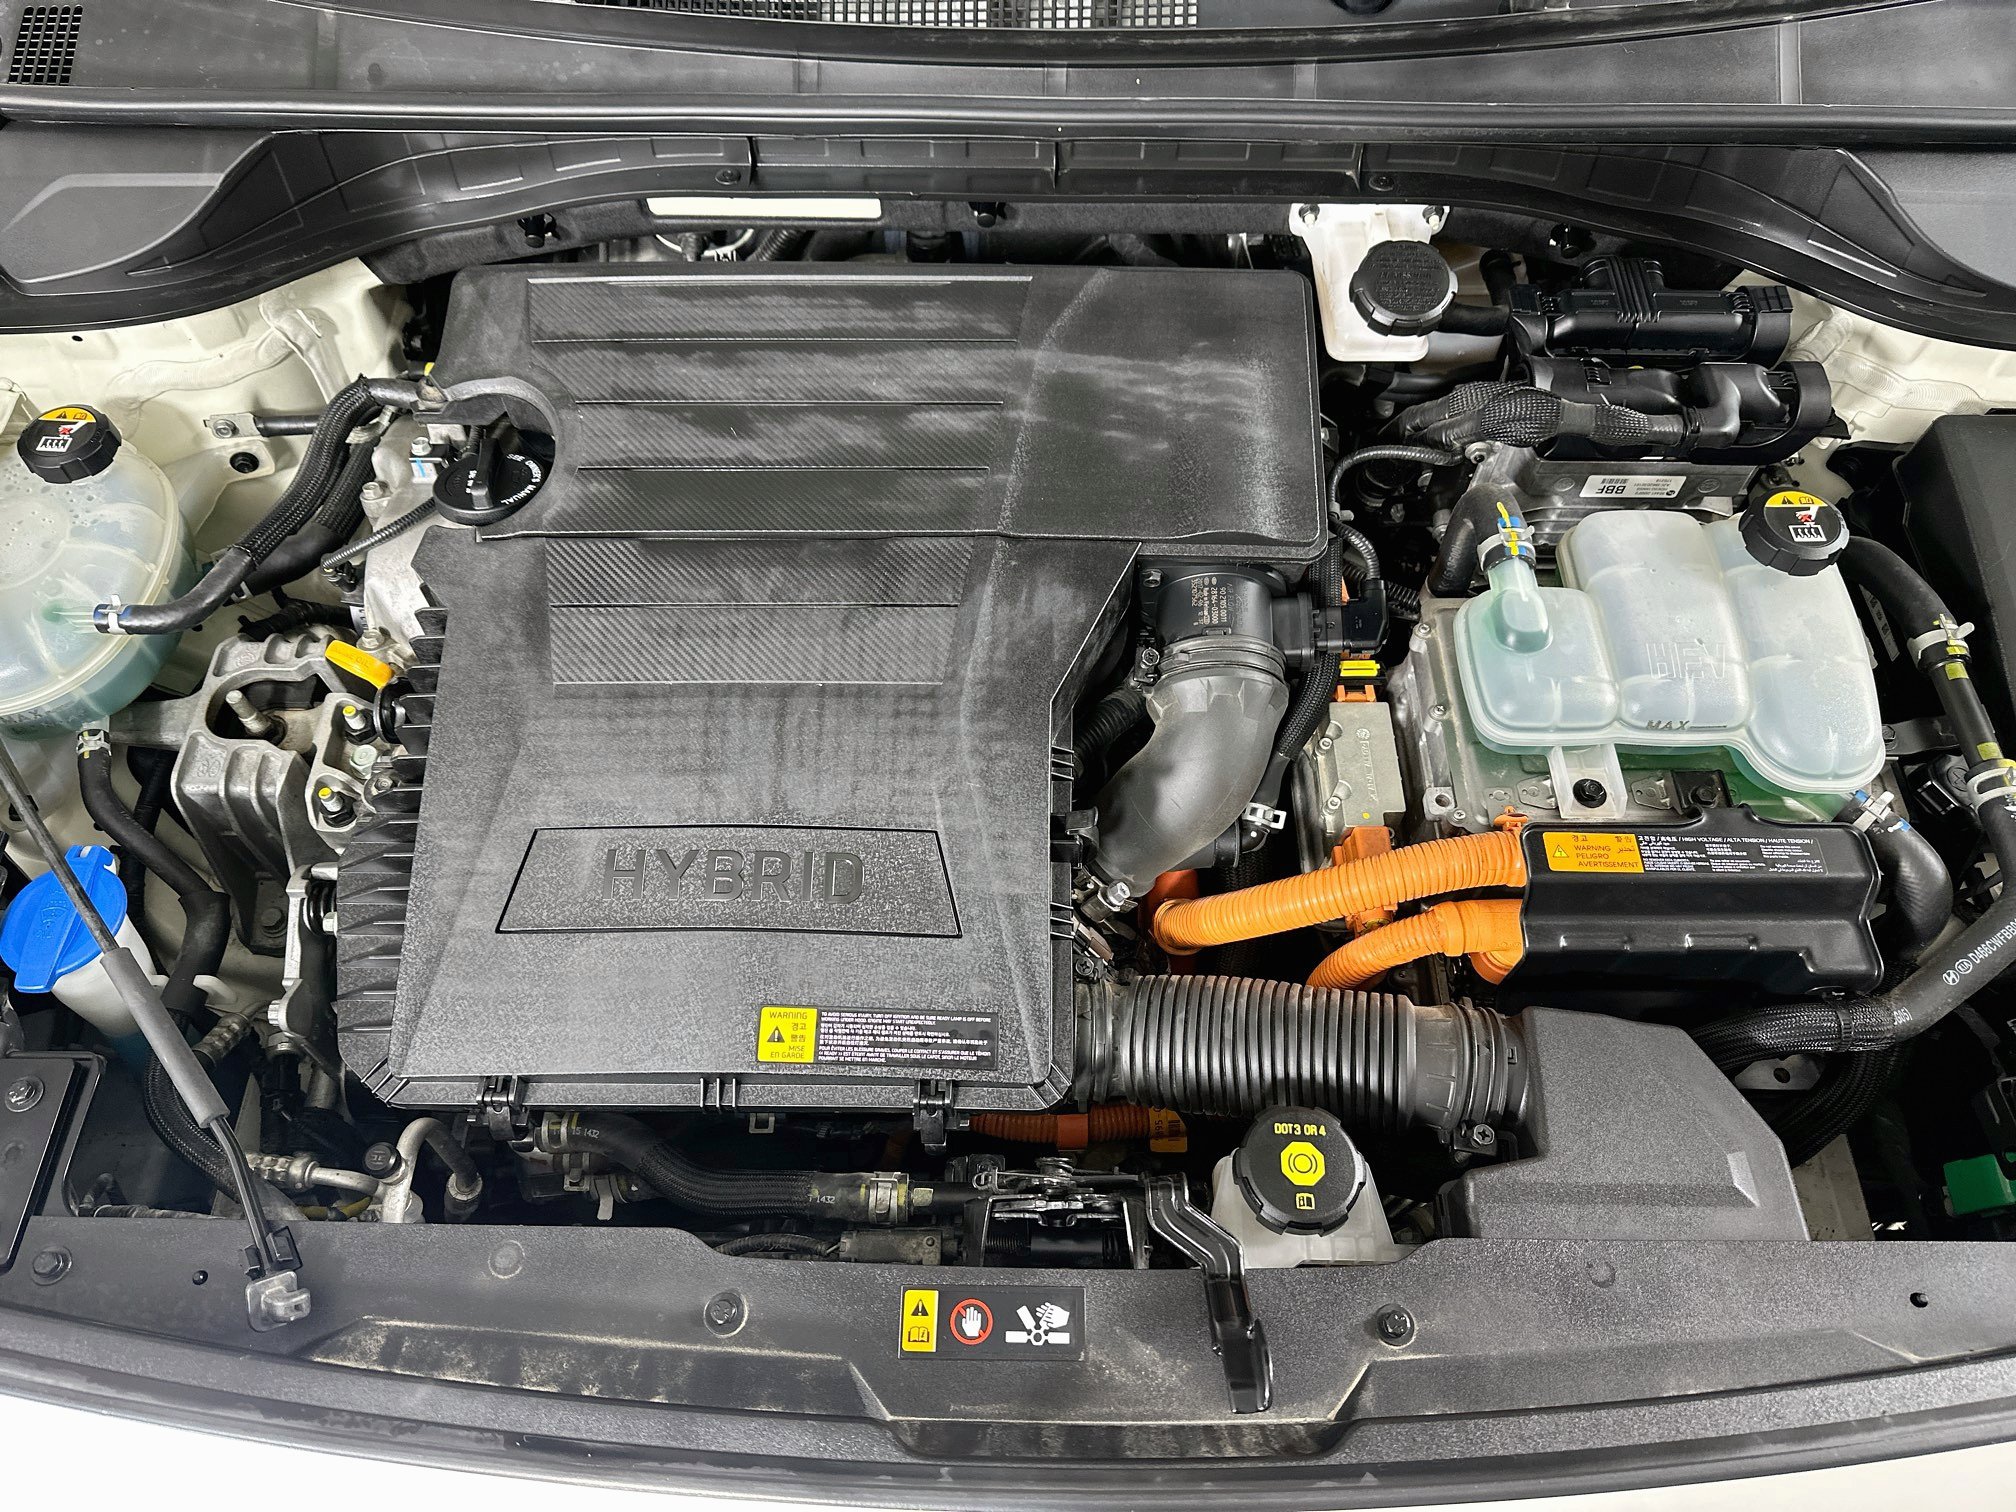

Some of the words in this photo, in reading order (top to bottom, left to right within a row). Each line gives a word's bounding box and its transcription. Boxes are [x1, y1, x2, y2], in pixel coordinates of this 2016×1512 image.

[506, 454, 525, 462] SEE
[525, 460, 541, 482] OWNER'S
[500, 485, 536, 504] MANUAL
[1596, 485, 1626, 494] BBF
[1646, 720, 1689, 731] MAX
[602, 850, 864, 904] HYBRID
[770, 1012, 808, 1020] WARNING
[792, 1023, 806, 1031] 경고
[1304, 1124, 1317, 1136] OR
[1319, 1125, 1326, 1136] 4
